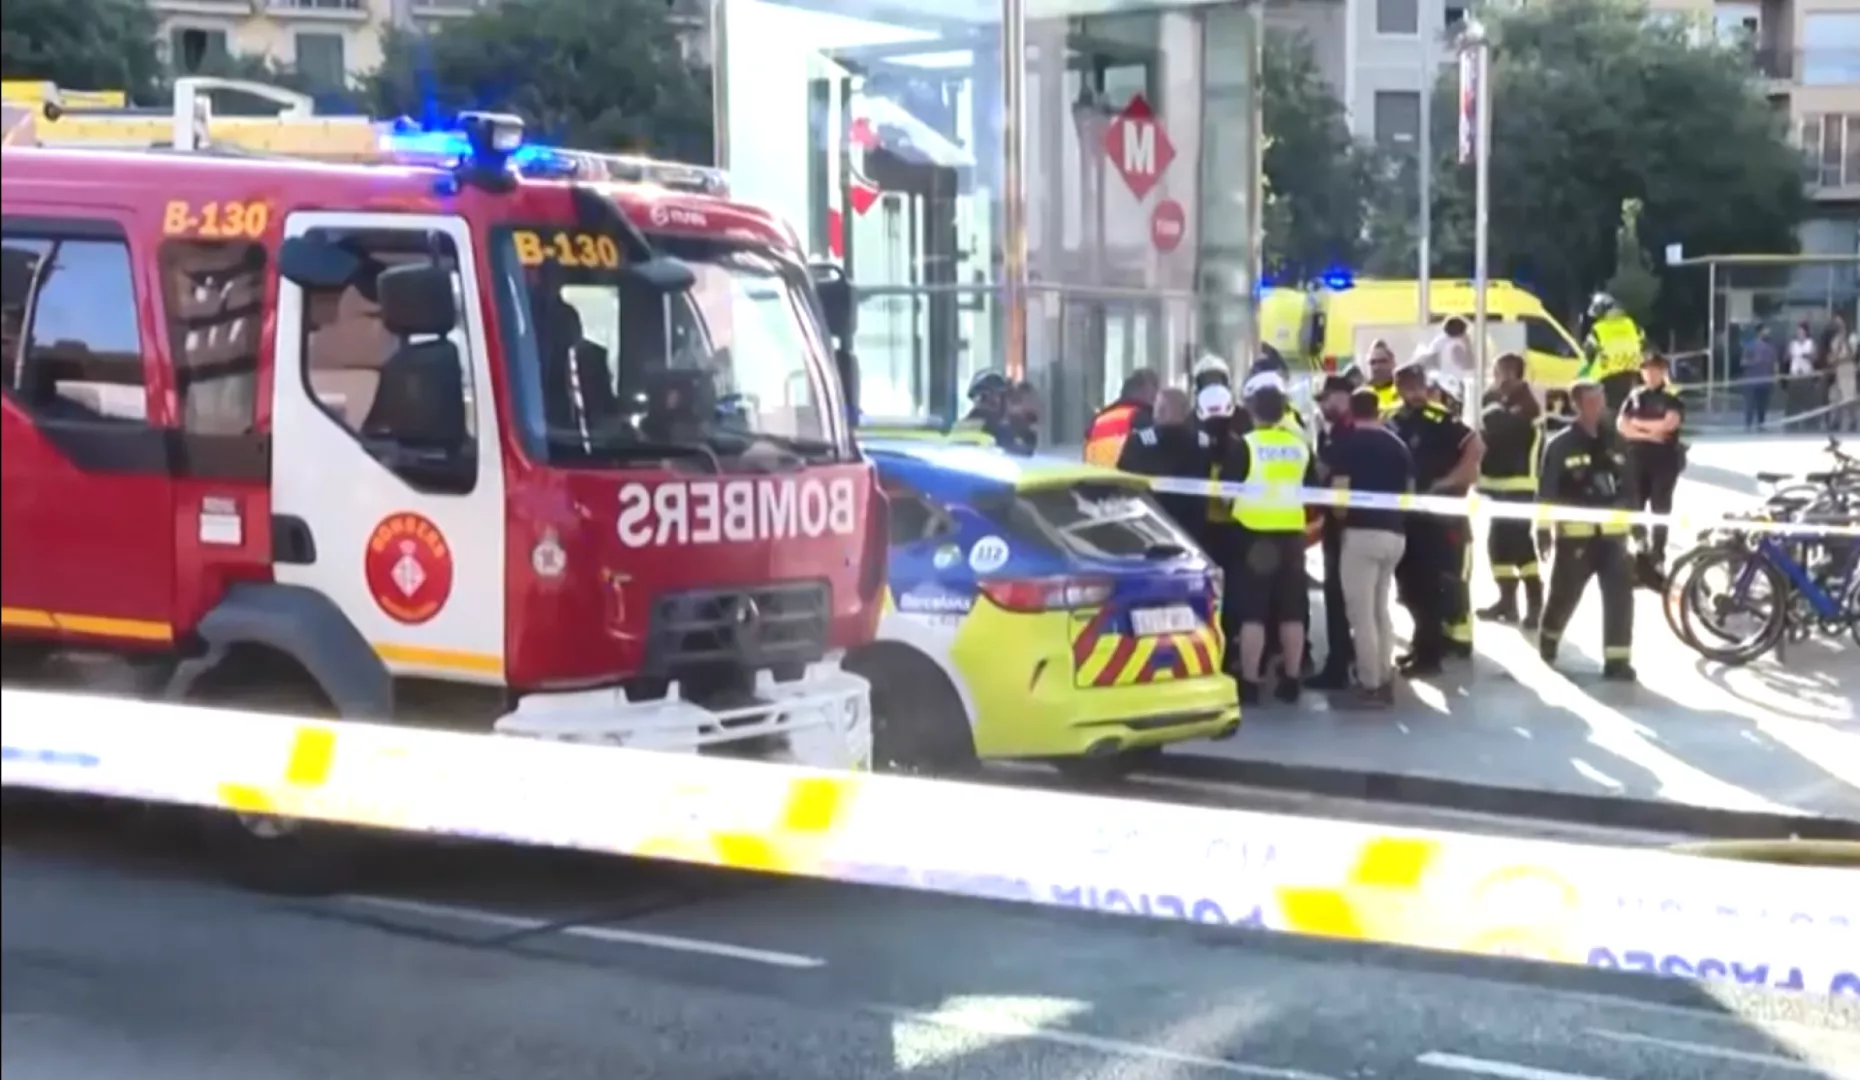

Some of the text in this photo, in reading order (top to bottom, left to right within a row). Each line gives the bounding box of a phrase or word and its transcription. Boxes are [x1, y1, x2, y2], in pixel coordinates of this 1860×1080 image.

[1123, 120, 1155, 175] M
[163, 200, 268, 238] B-130
[512, 229, 619, 268] B-130
